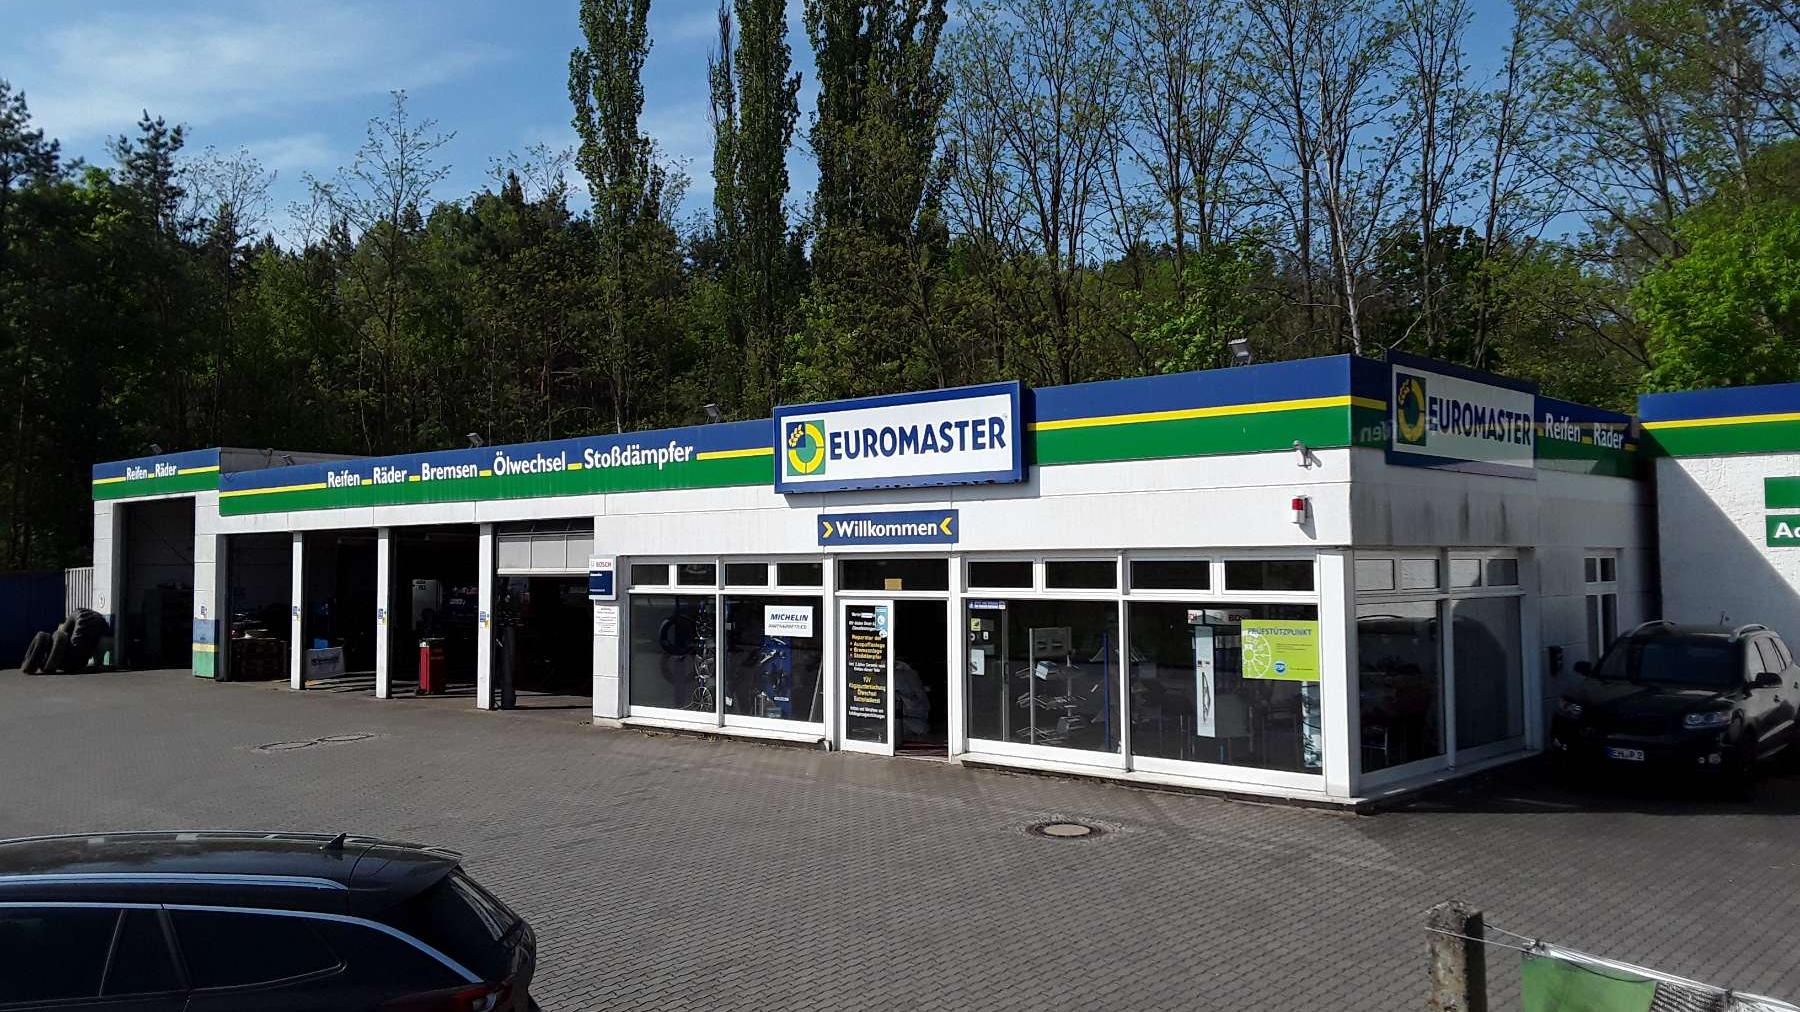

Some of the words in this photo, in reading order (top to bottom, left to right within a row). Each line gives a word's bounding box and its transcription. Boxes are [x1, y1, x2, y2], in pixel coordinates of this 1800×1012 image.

[829, 415, 1006, 460] EUROMASTER
[1429, 395, 1533, 446] EUROMASTER
[1544, 411, 1581, 442] Reifen
[1592, 421, 1624, 449] Räder
[125, 466, 150, 481] Reifen
[153, 462, 177, 478] Räder
[327, 468, 361, 487] Reifen
[371, 464, 408, 484] Räder
[420, 459, 478, 481] Bremsen
[491, 450, 566, 476] Ölwechsel
[583, 440, 693, 470] Stoßdämpfer
[836, 519, 937, 538] Willkommen
[770, 613, 809, 622] MICHELIN
